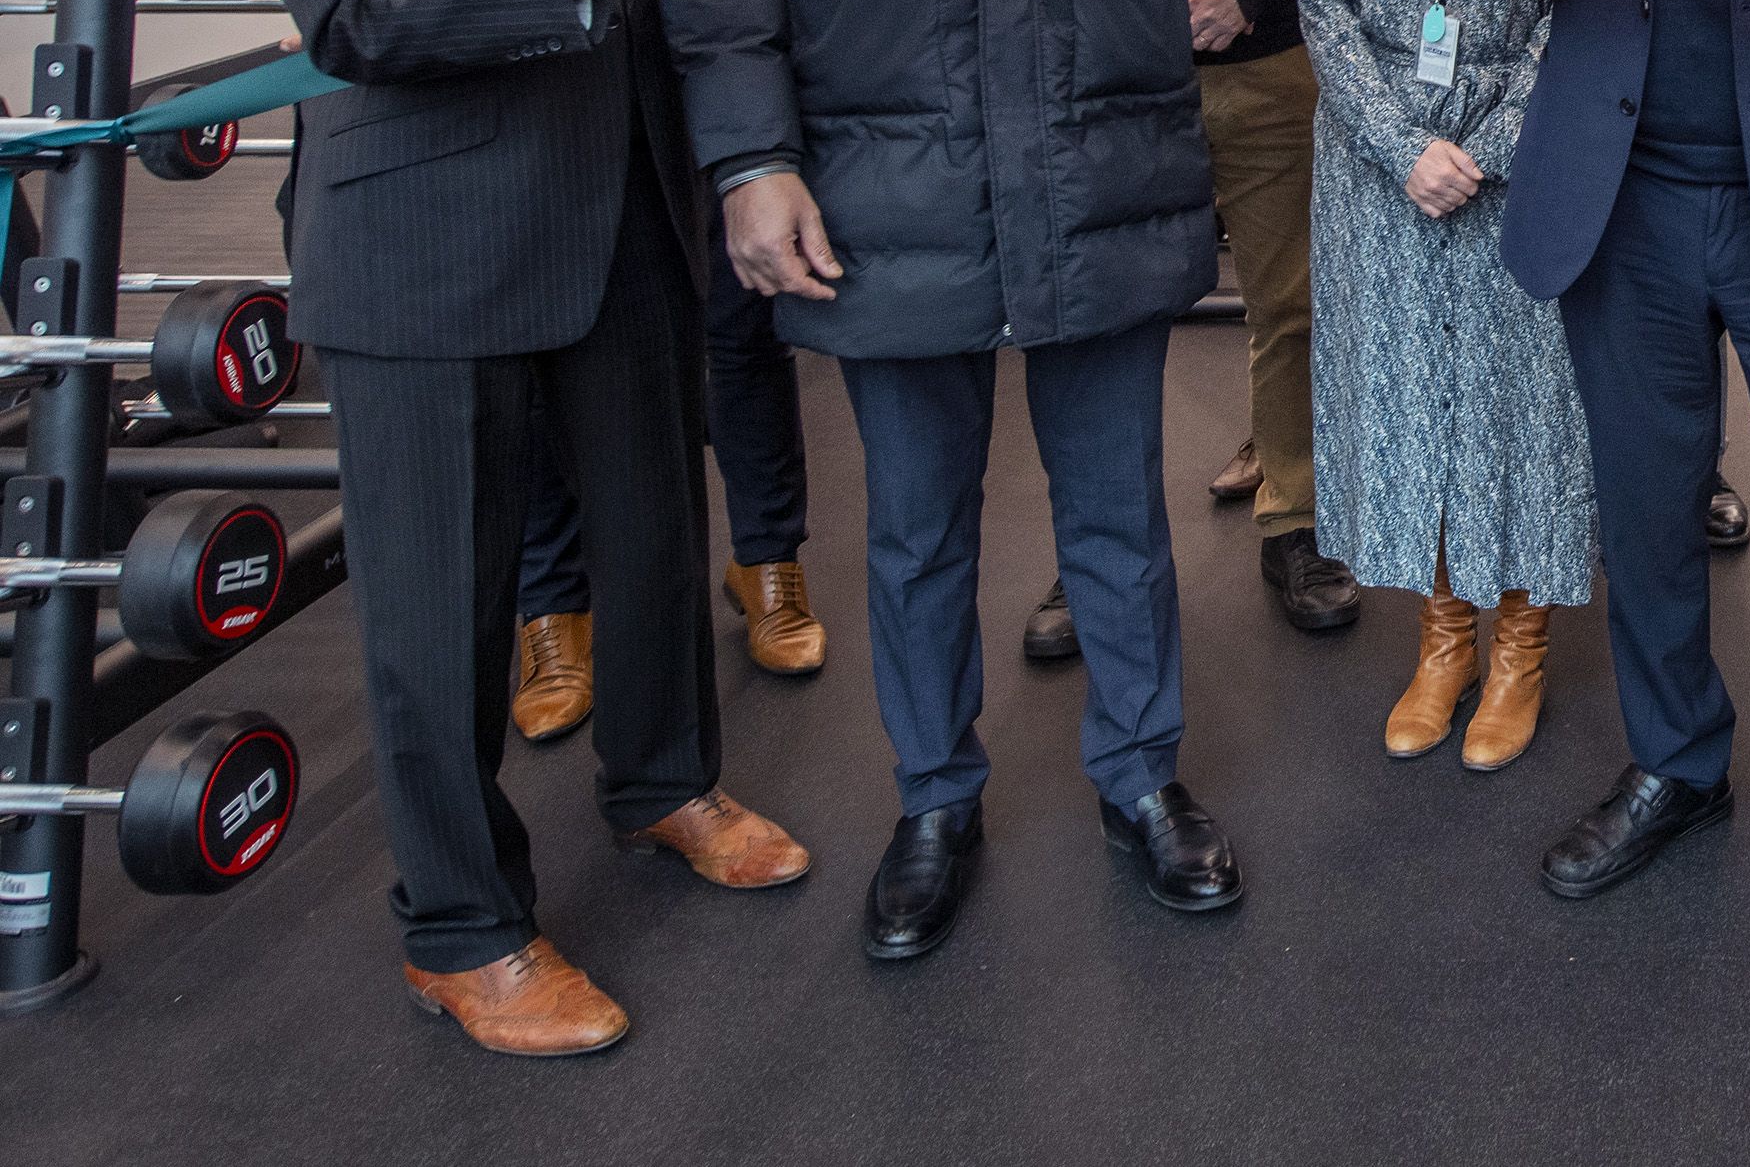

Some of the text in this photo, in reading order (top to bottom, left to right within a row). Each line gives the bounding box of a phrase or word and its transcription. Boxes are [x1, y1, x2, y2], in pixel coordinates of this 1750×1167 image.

[242, 318, 278, 385] 20
[216, 554, 269, 594] 25
[220, 767, 277, 840] 30
